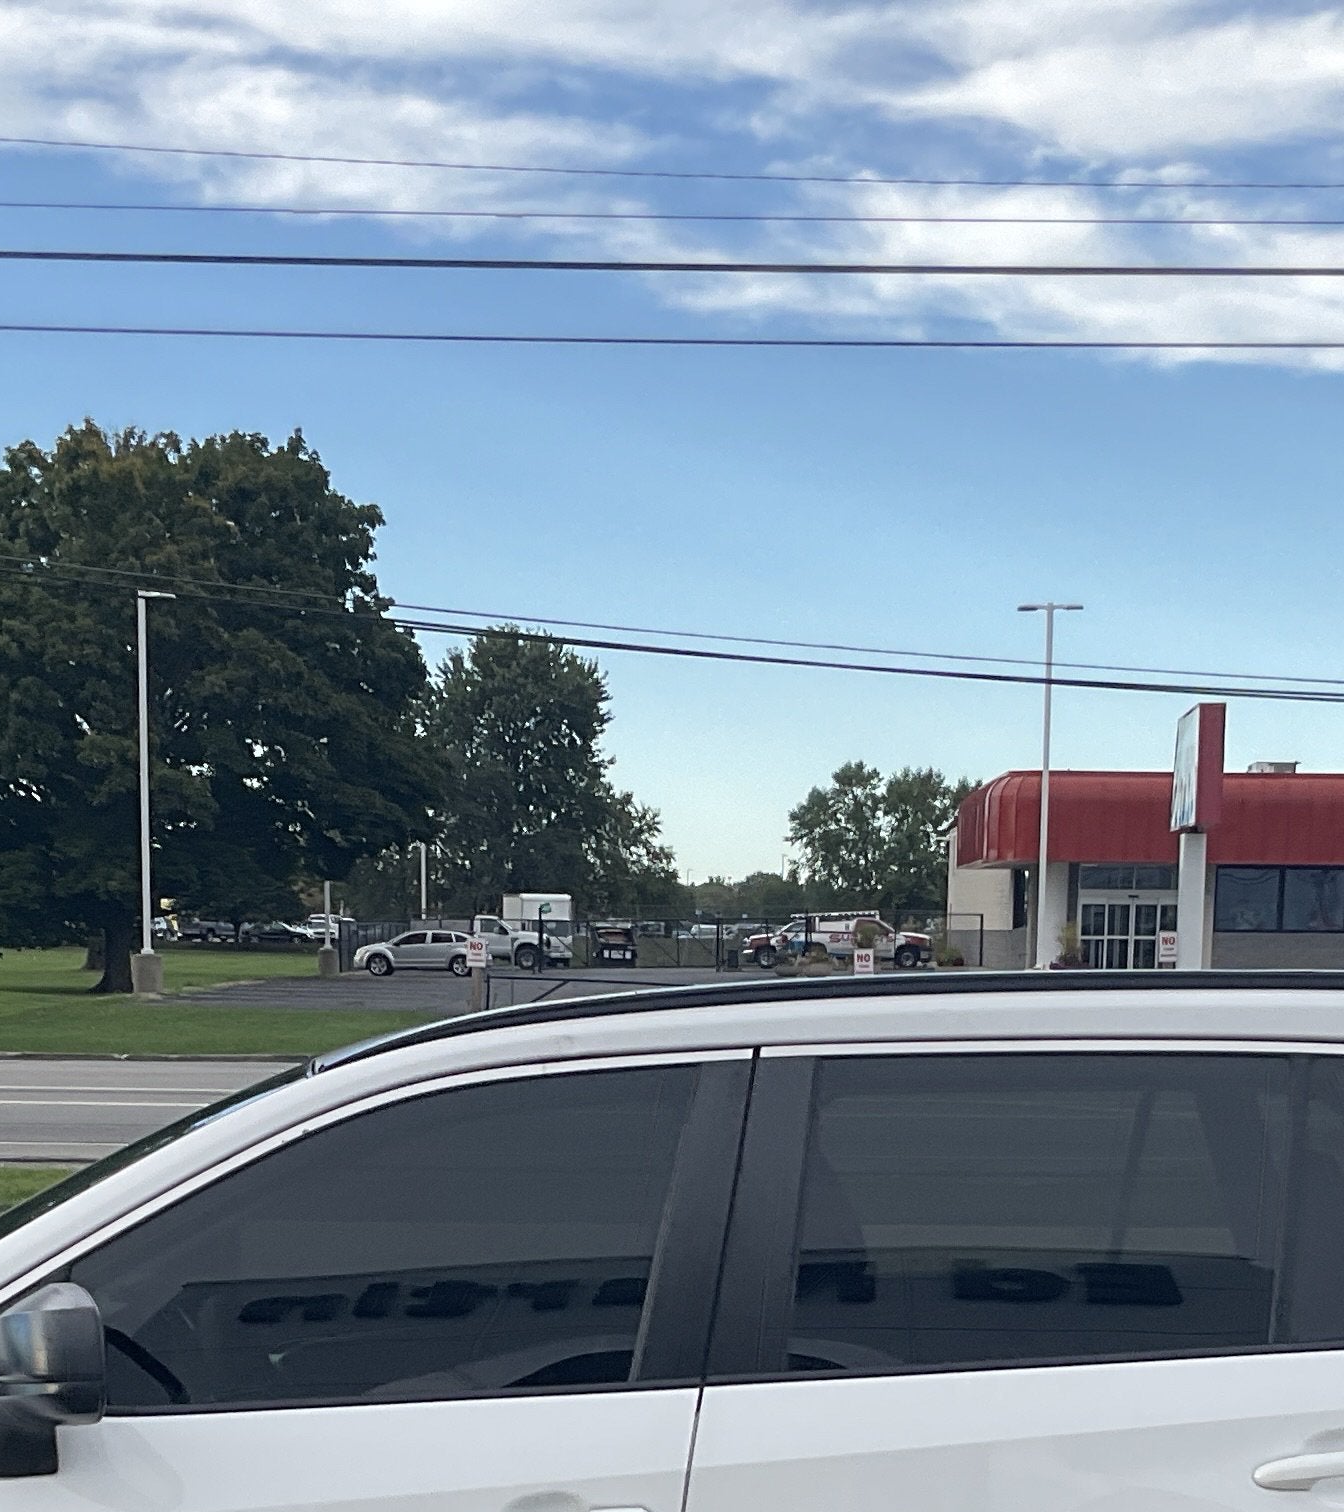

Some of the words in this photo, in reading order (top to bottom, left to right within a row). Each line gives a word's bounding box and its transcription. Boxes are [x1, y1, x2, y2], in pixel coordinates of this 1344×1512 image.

[469, 941, 484, 951] NO
[1161, 936, 1176, 946] NO
[856, 953, 871, 963] NO
